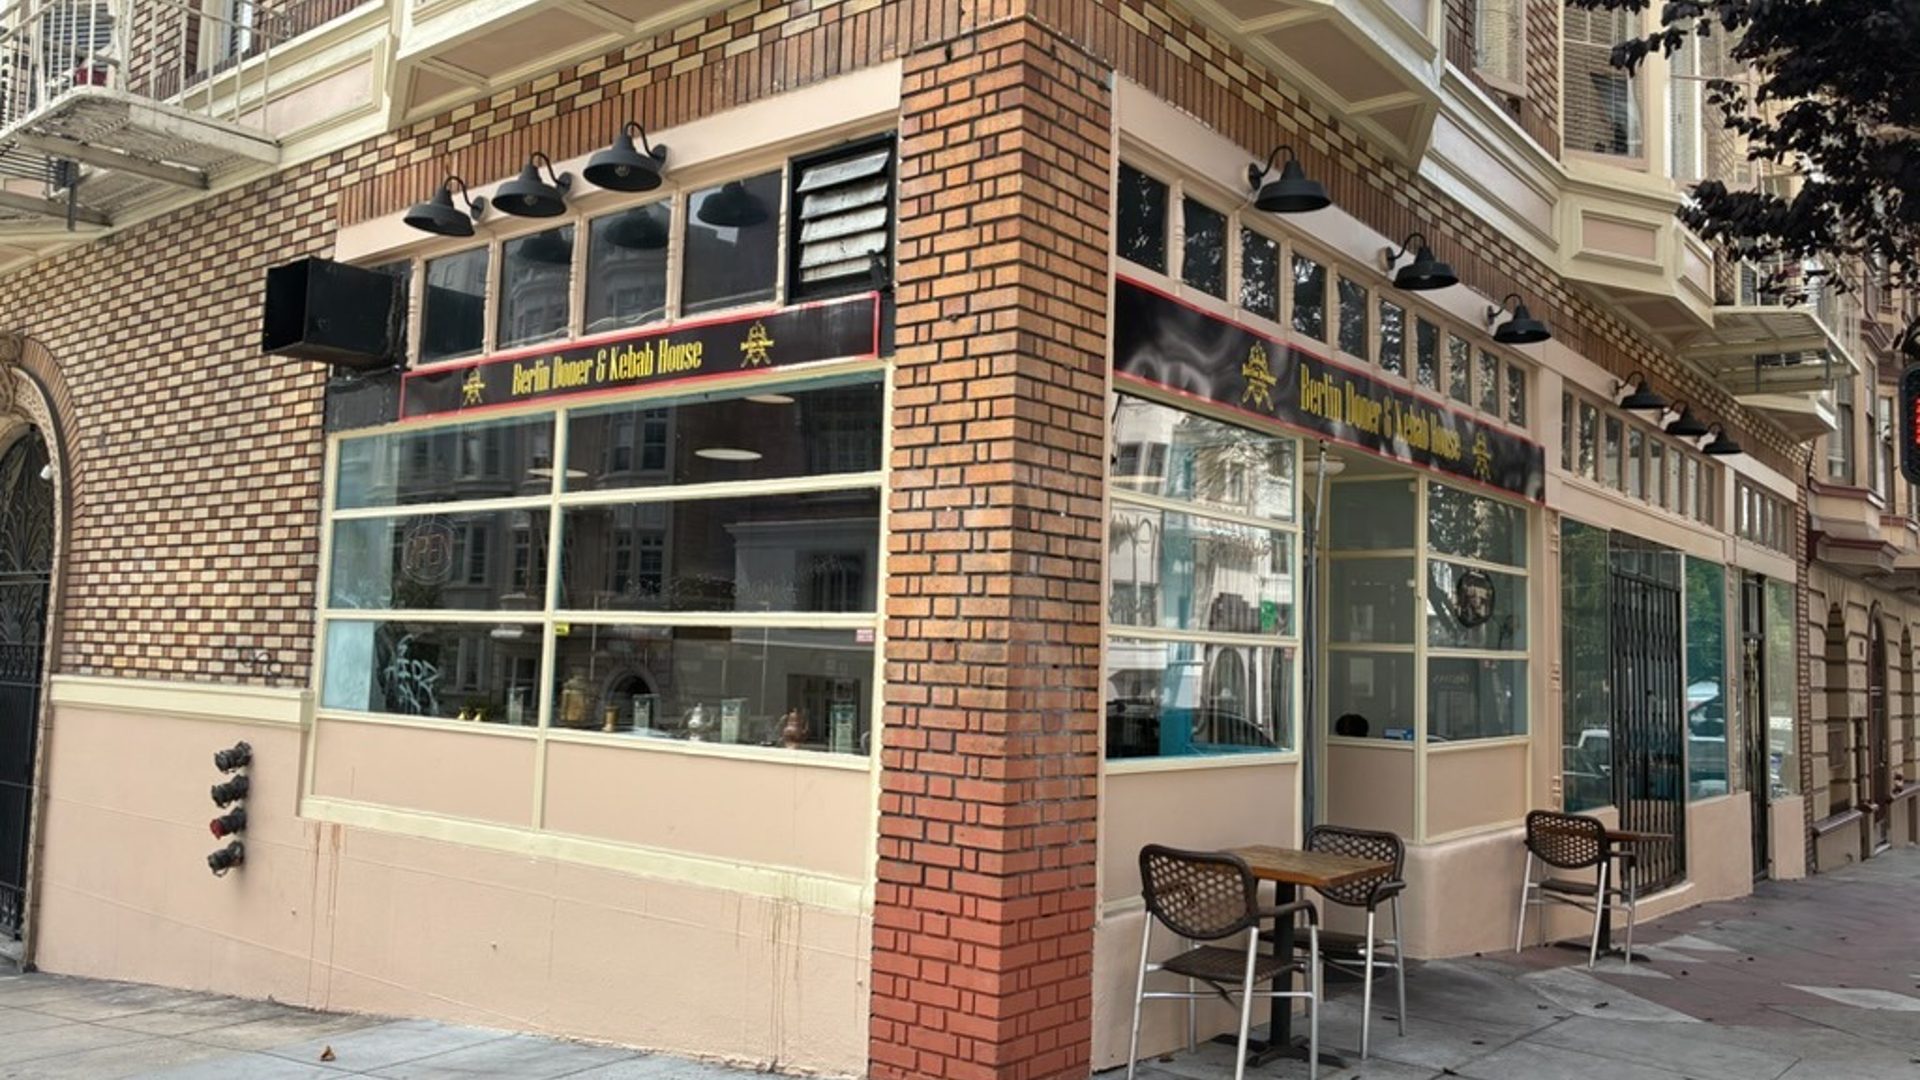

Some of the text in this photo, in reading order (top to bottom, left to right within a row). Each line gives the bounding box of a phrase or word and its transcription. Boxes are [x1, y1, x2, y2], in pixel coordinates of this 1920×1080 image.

[513, 339, 702, 395] Berlin Doner & Kebab House
[1301, 363, 1342, 422] Berlin
[1345, 380, 1382, 434] Doner
[1395, 400, 1430, 450] Kebab
[1431, 413, 1462, 461] House
